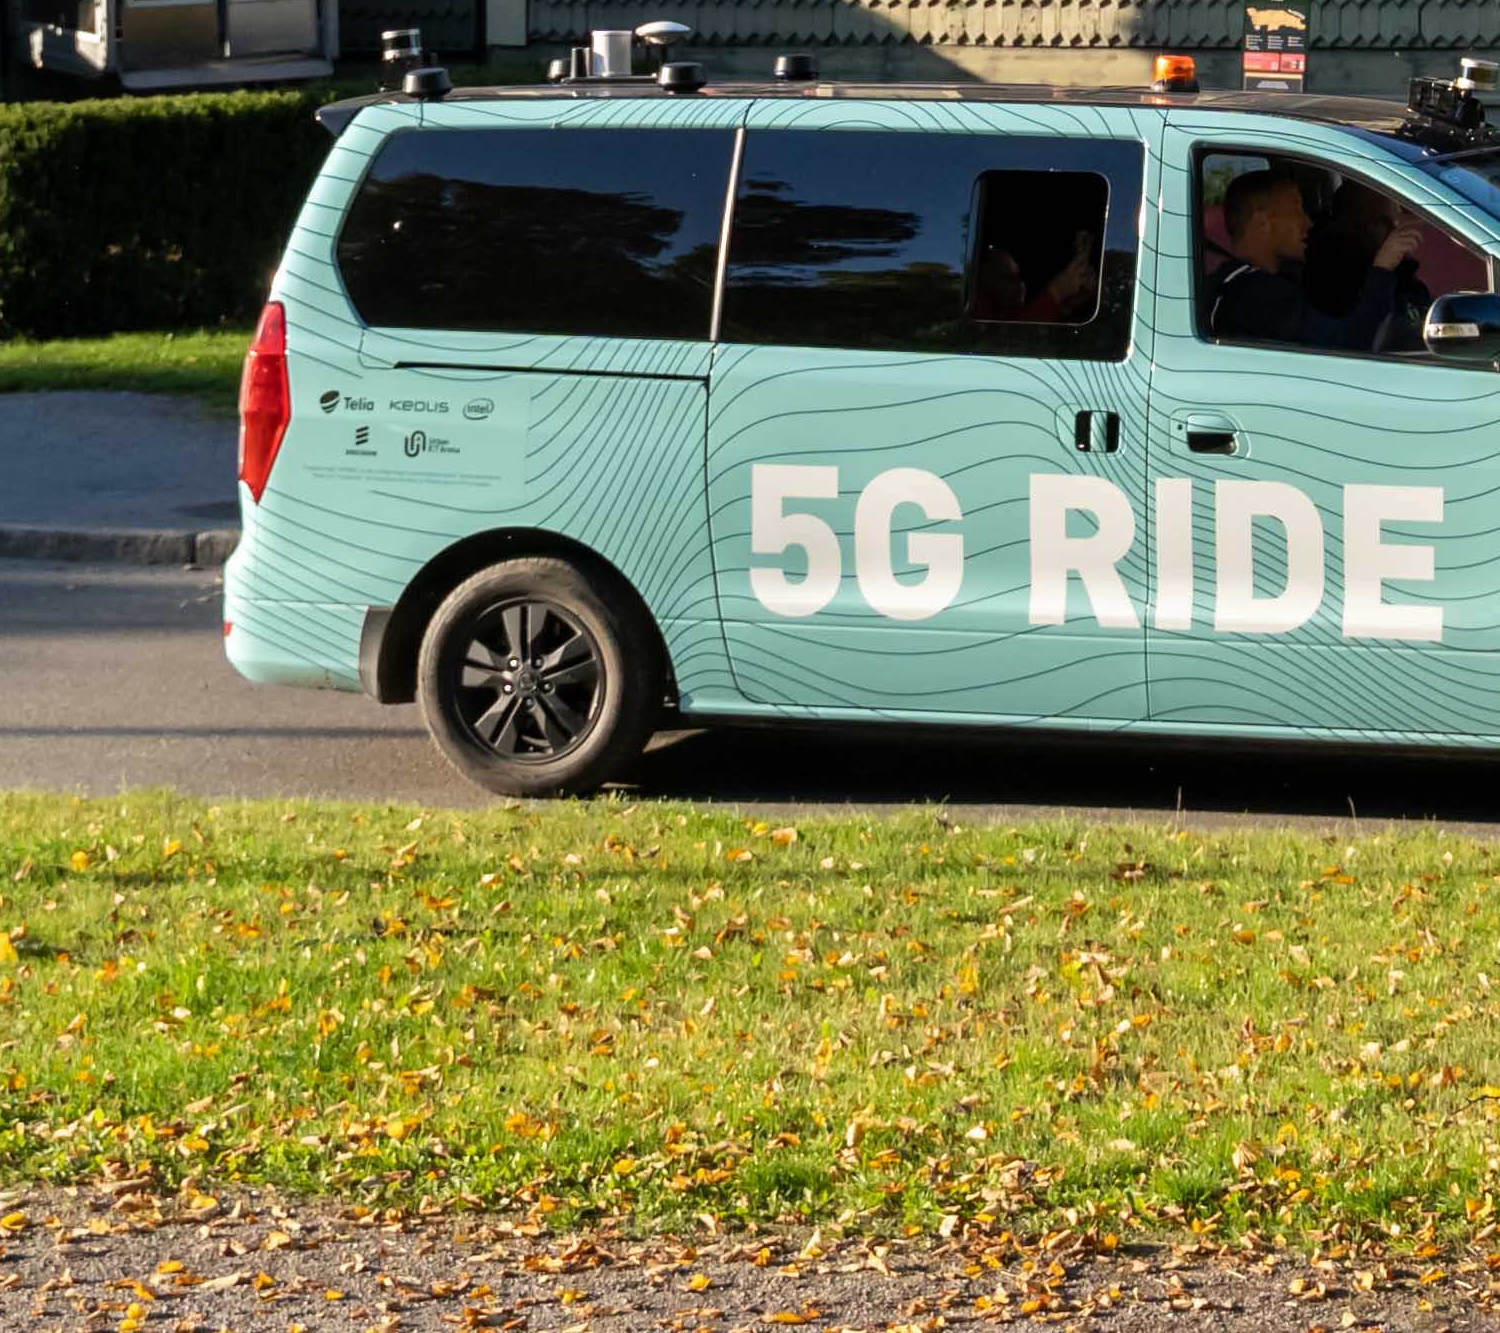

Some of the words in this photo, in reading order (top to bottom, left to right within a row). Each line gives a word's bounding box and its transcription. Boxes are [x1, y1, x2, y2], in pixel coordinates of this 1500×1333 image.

[344, 396, 375, 412] Telia
[750, 463, 965, 621] 5G
[1027, 473, 1445, 643] RIDE
